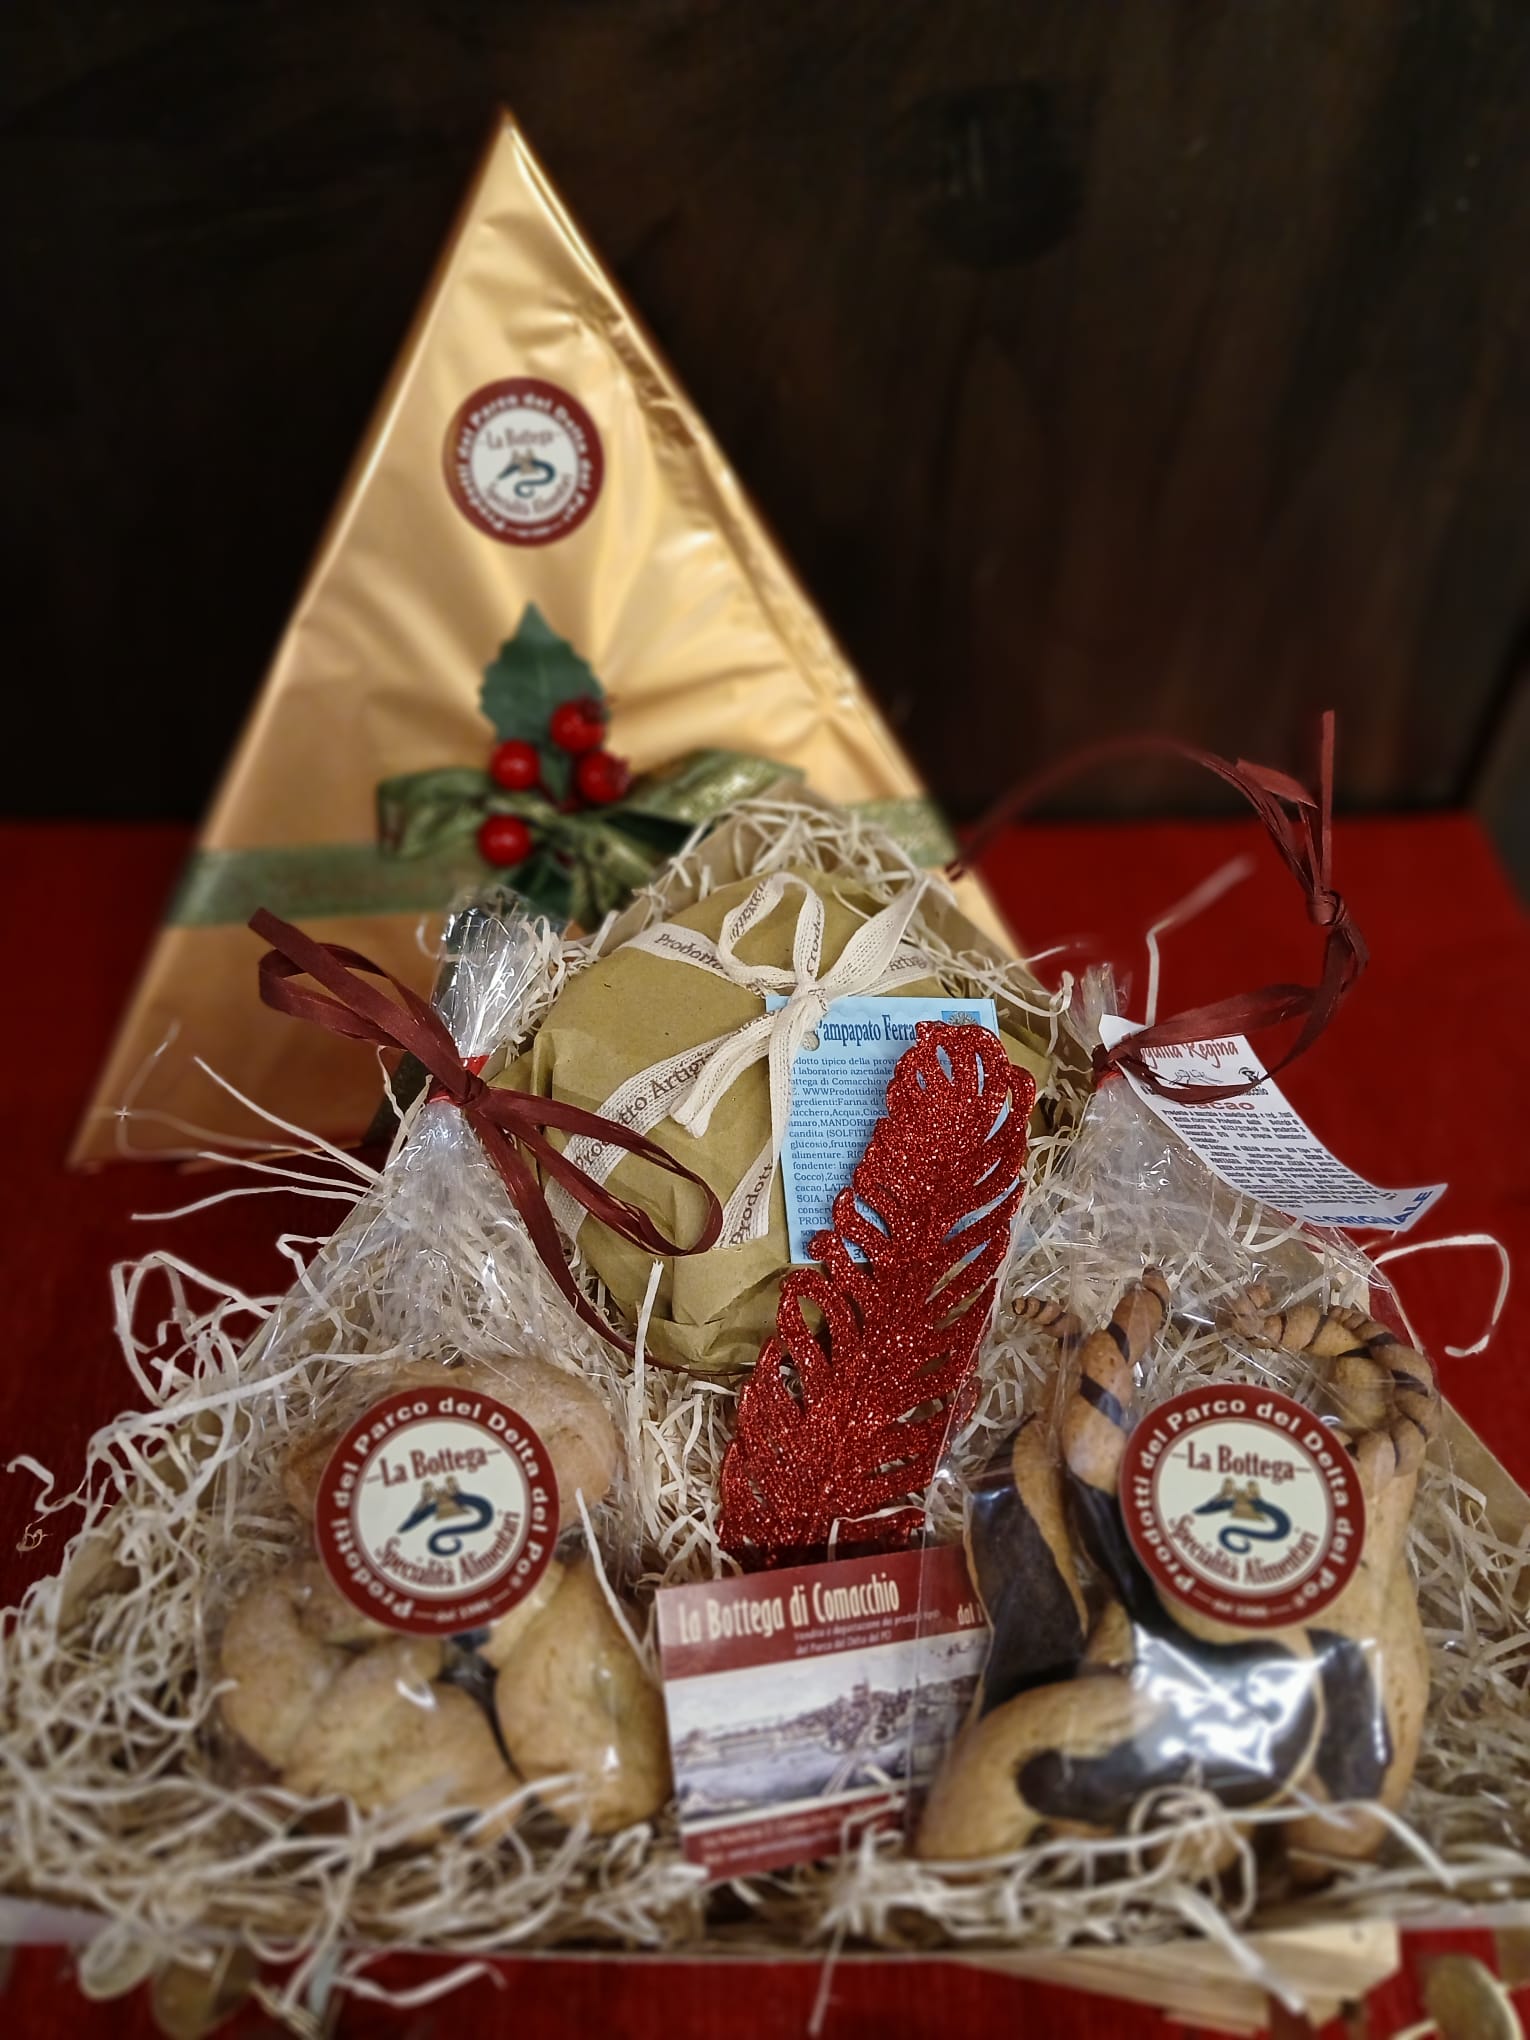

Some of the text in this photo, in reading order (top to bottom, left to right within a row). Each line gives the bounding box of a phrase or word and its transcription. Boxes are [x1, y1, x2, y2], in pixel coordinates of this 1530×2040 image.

[798, 1066, 848, 1076] laboratorio
[850, 1066, 893, 1076] aziendale
[820, 1077, 830, 1087] di
[831, 1077, 884, 1087] Comacchio
[822, 1056, 847, 1069] tipico
[848, 1056, 871, 1066] della
[789, 1128, 824, 1139] candita
[793, 1160, 837, 1170] fondente:
[353, 1400, 430, 1455] Parco
[438, 1396, 482, 1419] del
[1166, 1399, 1246, 1432] Parco
[1256, 1402, 1301, 1433] del
[487, 1412, 541, 1477] Delta
[1140, 1430, 1168, 1469] del
[1187, 1441, 1296, 1485] La Bottega
[333, 1461, 359, 1509] del
[379, 1446, 489, 1489] La Bottega
[1303, 1431, 1350, 1506] Delta
[531, 1487, 549, 1533] del
[1133, 1475, 1196, 1593] Prodotti
[1328, 1517, 1354, 1565] del
[330, 1519, 416, 1620] Prodotti
[706, 1597, 786, 1640] Bottega
[789, 1584, 810, 1628] di
[812, 1572, 901, 1624] Comacchio
[957, 1601, 976, 1626] dal
